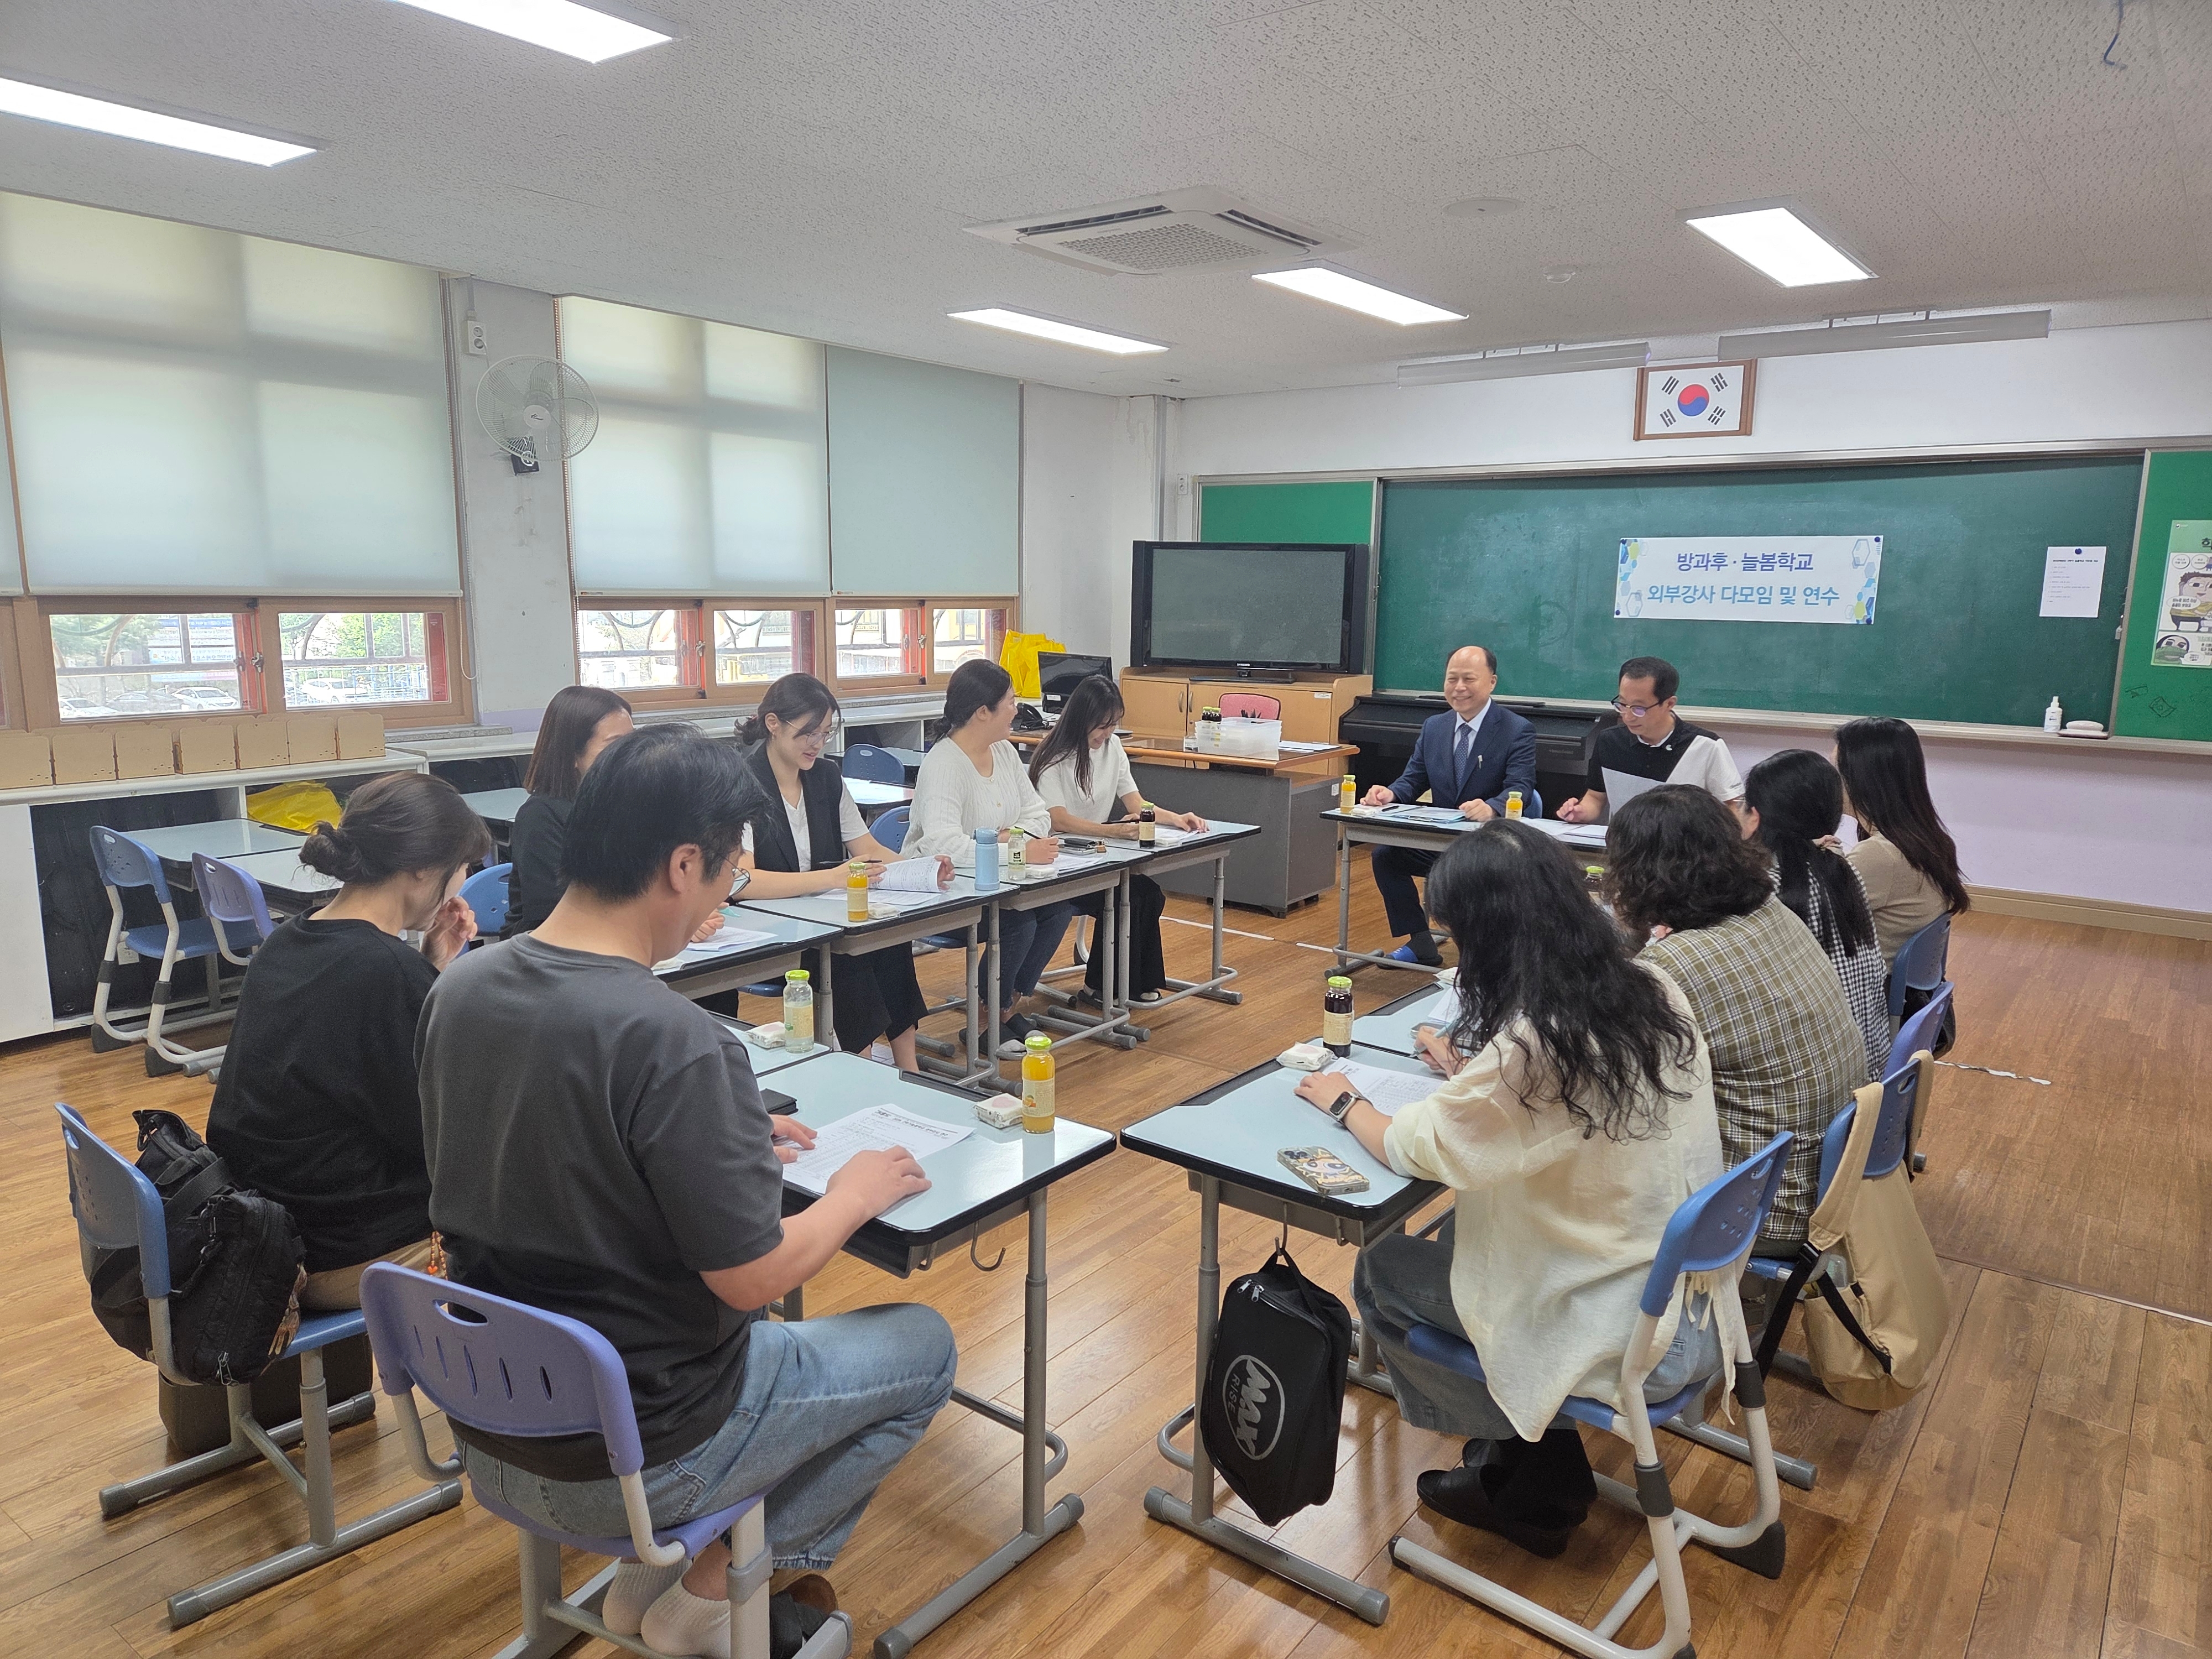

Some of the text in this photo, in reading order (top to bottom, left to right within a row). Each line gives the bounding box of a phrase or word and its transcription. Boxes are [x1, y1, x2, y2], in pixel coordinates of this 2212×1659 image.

[1677, 552, 1728, 572] 방과후
[1741, 552, 1814, 572] 늘봄학교
[1647, 585, 1840, 606] 외부강사 다모임 및 연수
